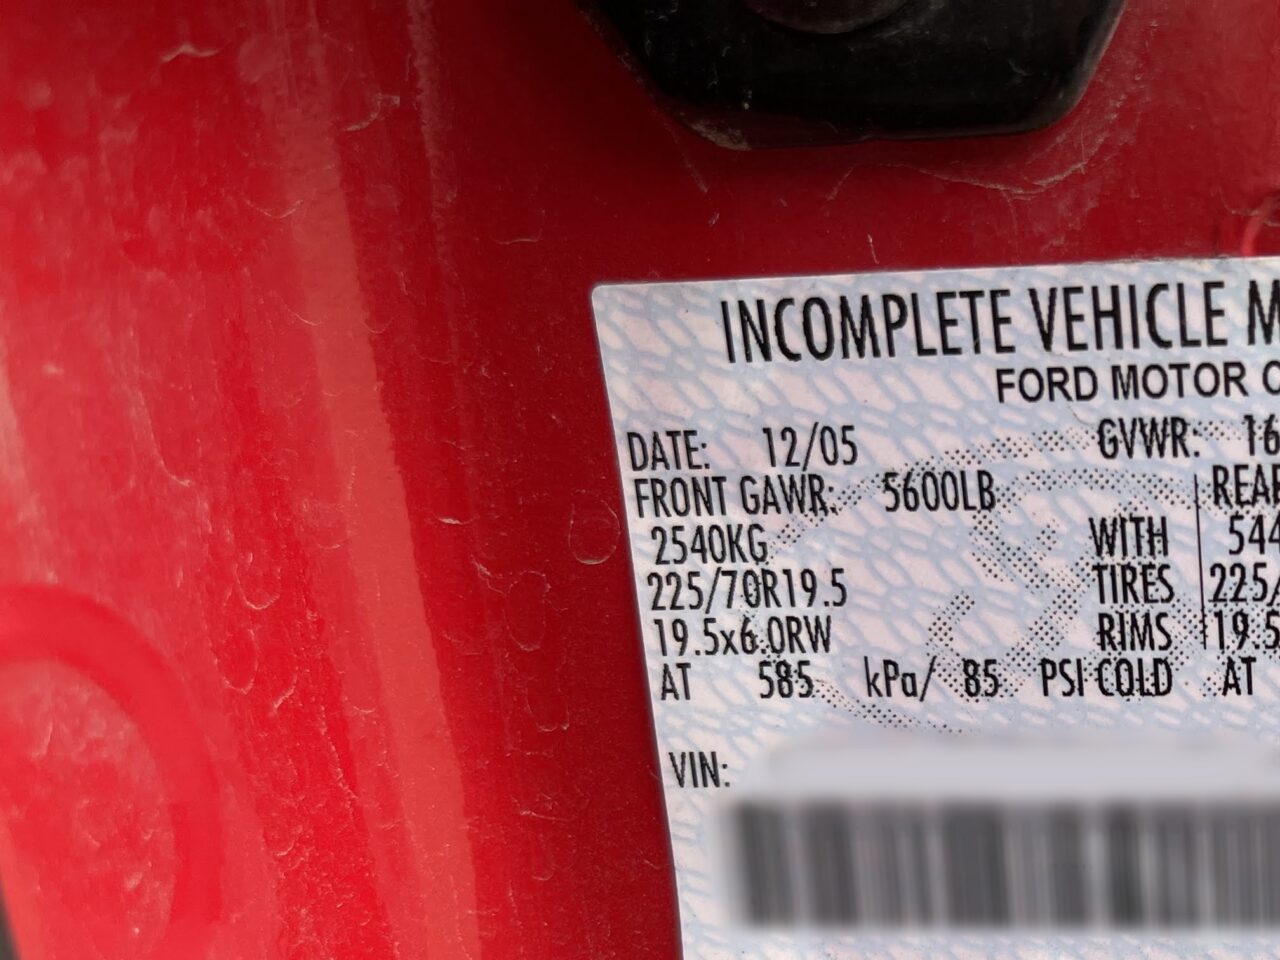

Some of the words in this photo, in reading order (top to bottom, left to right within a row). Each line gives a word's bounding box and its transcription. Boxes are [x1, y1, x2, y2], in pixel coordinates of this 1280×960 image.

[721, 290, 1015, 363] INCOMPLETE
[1028, 281, 1227, 351] VEHICLE
[996, 367, 1098, 402] FORD
[1112, 361, 1249, 400] MOTOR
[627, 429, 710, 472] DATE:
[762, 422, 859, 472] 12/05
[1097, 417, 1200, 459] GVWR:
[634, 475, 728, 518] FRONT
[740, 473, 838, 516] GAWR:
[883, 470, 996, 512] 5600LB
[651, 524, 768, 565] 2540KG
[1088, 516, 1169, 557] WITH
[647, 567, 848, 614] 225/70R19.5
[1092, 563, 1175, 604] TIRES
[654, 616, 832, 657] 19.5x6.0RW
[1098, 612, 1172, 652] RIMS
[661, 661, 692, 700] AT
[758, 659, 815, 700] 585
[864, 655, 937, 702] kPa/
[962, 657, 999, 698] 85
[1039, 658, 1085, 698] PSI
[1099, 657, 1174, 697] COLD
[1222, 656, 1256, 696] AT
[668, 751, 731, 789] VIN:
